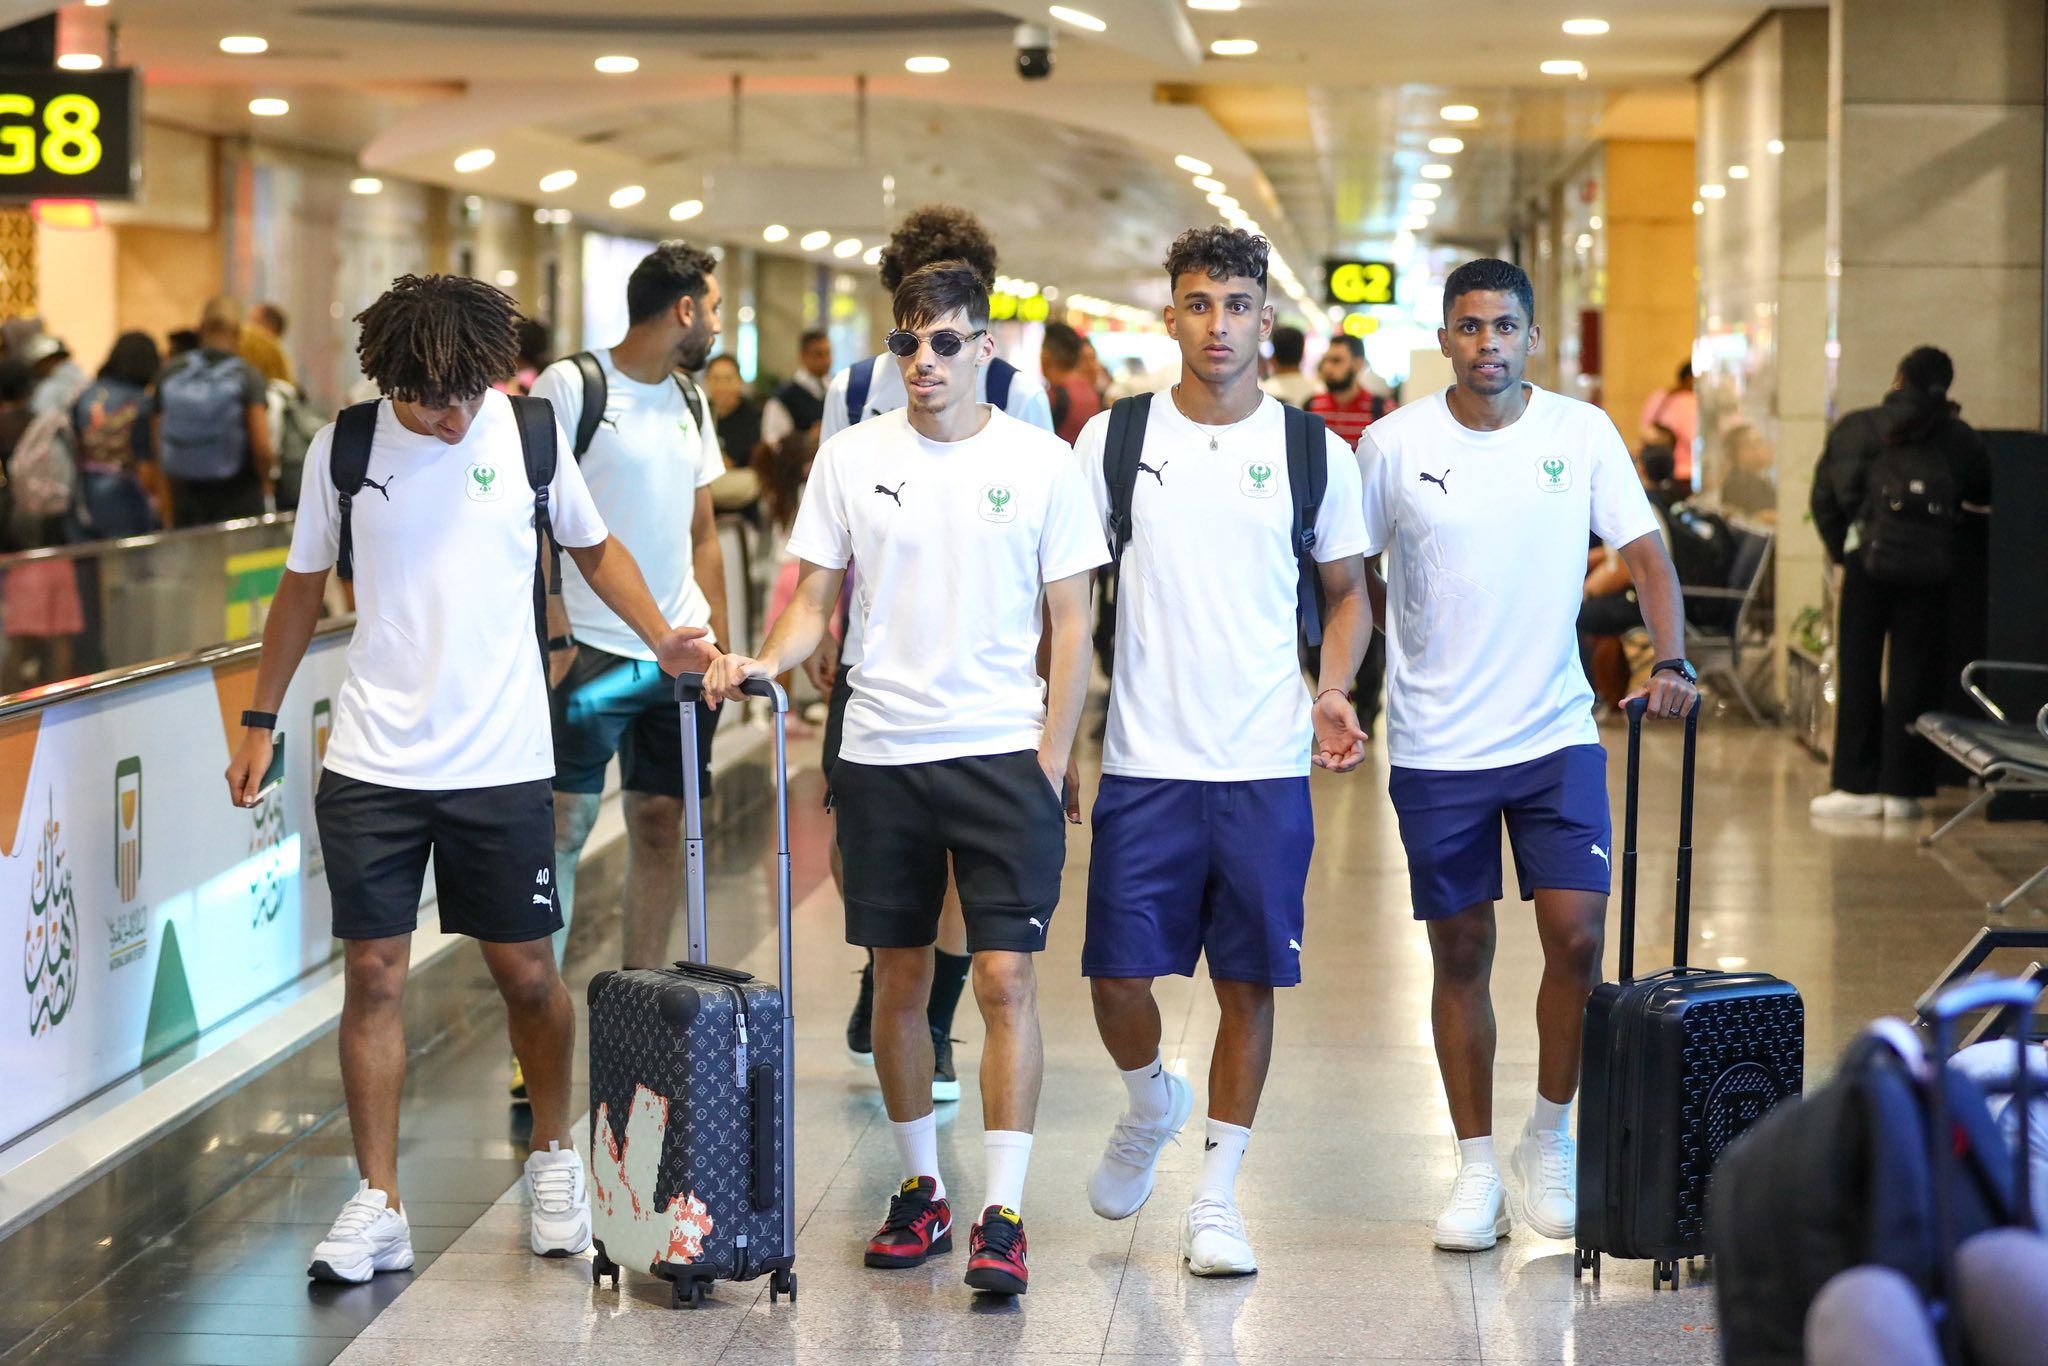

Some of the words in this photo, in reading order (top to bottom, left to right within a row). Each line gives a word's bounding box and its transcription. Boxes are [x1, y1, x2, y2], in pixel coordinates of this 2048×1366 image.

[0, 93, 103, 175] G8
[1330, 263, 1391, 303] G2
[536, 868, 549, 885] 40
